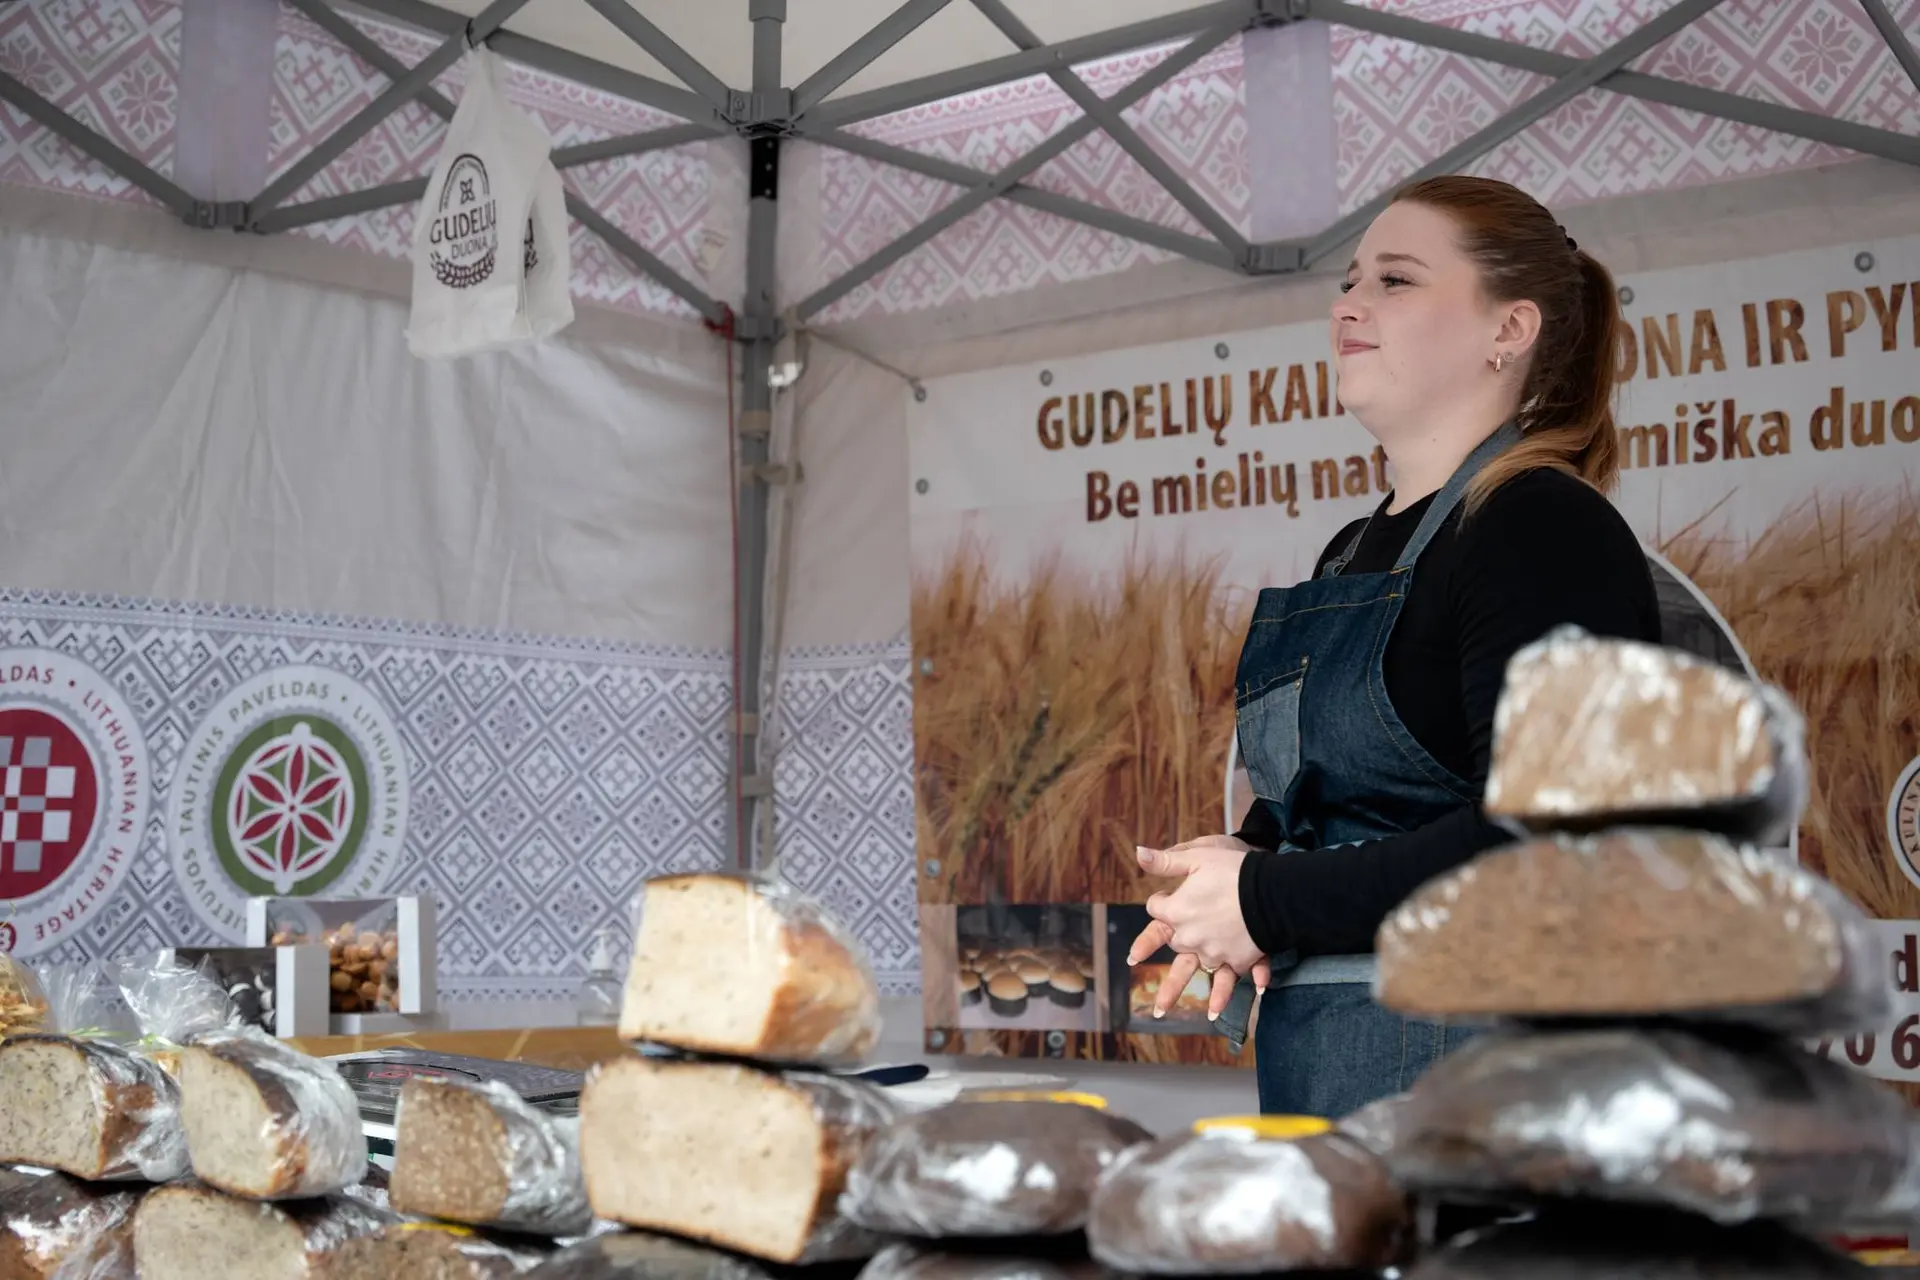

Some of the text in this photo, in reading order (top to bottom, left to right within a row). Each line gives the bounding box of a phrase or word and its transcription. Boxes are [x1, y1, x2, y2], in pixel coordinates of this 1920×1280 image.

[452, 235, 488, 259] DUONA
[1037, 373, 1233, 450] GUDELIŲ
[1741, 297, 1810, 368] IR
[1086, 470, 1139, 522] Be
[1152, 450, 1300, 518] mielių
[1618, 398, 1792, 469] miška
[1809, 386, 1920, 451] duo
[34, 689, 137, 940] LITHUANIAN HERITAGE
[180, 725, 224, 835] TAUTINIS
[228, 680, 331, 722] PAVELDAS
[353, 705, 399, 838] LITHUANIAN
